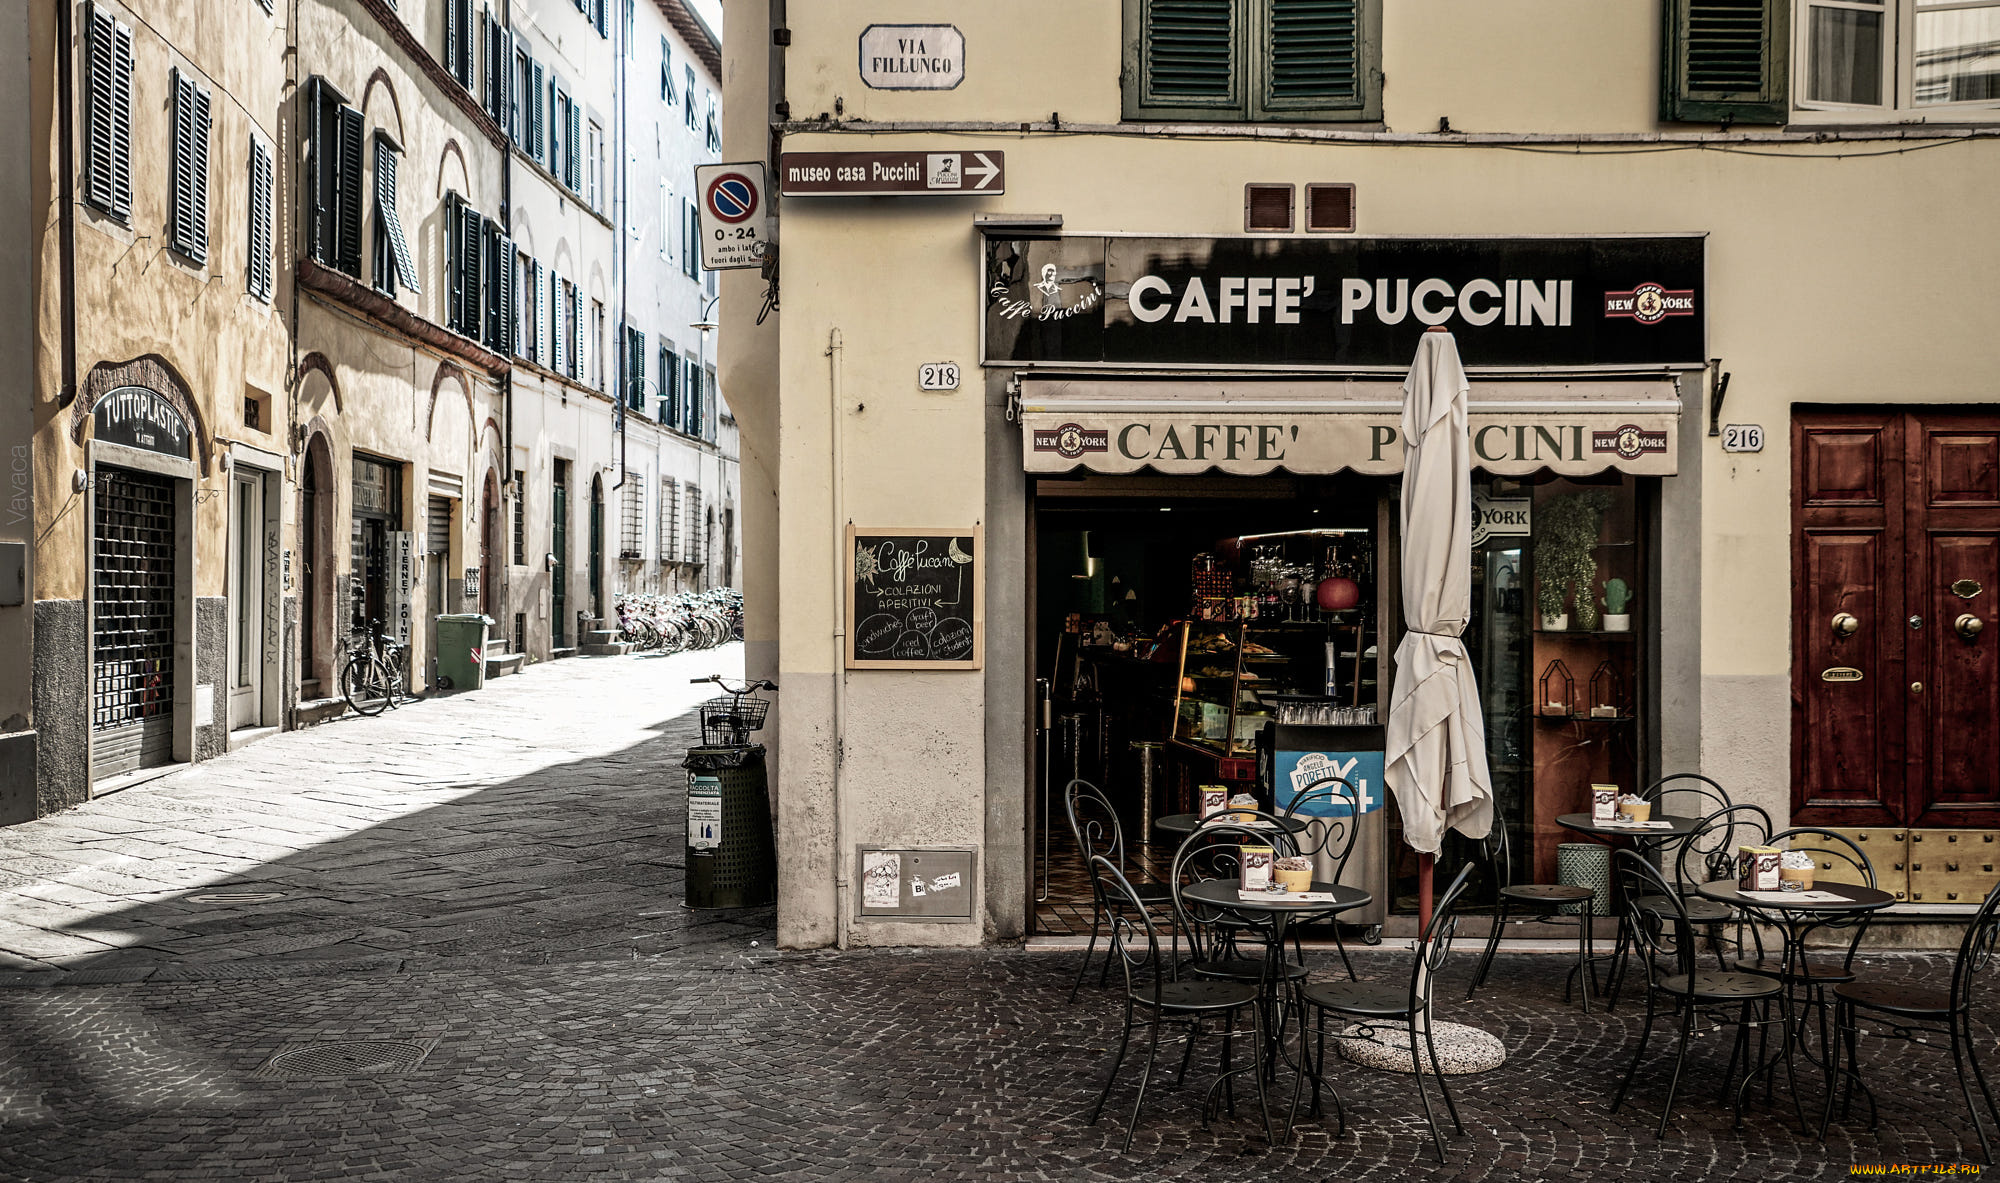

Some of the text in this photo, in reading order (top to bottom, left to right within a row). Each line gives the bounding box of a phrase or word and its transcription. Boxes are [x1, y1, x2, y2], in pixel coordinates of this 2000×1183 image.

[898, 39, 926, 54] VIA
[873, 57, 952, 73] FILLUNGO
[789, 162, 920, 181] museo casa Puccini
[715, 229, 725, 240] 0
[736, 227, 756, 240] 24
[718, 245, 735, 253] ambo
[737, 244, 740, 253] i
[742, 244, 755, 252] lat
[711, 256, 727, 264] fuori
[729, 255, 746, 264] dagli
[1039, 282, 1102, 321] Puccini
[1128, 275, 1573, 326] CAFFE' PUCCINI
[1607, 297, 1693, 310] NEW YORK
[925, 367, 955, 385] 218
[105, 394, 180, 442] TUTTOPLASTIC
[1036, 436, 1107, 446] NEW YORK
[1117, 423, 1588, 461] CAFFE' PCINI
[1594, 437, 1665, 447] NEW YORK
[1727, 429, 1759, 447] 216
[1482, 508, 1528, 525] YORK
[915, 540, 955, 571] Puccini
[401, 533, 409, 593] INTERNET
[884, 584, 941, 596] COLAZIONI
[879, 599, 931, 610] APERITIVI
[910, 610, 933, 622] draft
[915, 621, 932, 629] beer
[903, 635, 920, 647] iced
[897, 648, 924, 657] coffee
[1303, 761, 1324, 771] ANGELO
[1296, 766, 1337, 788] PORETTI
